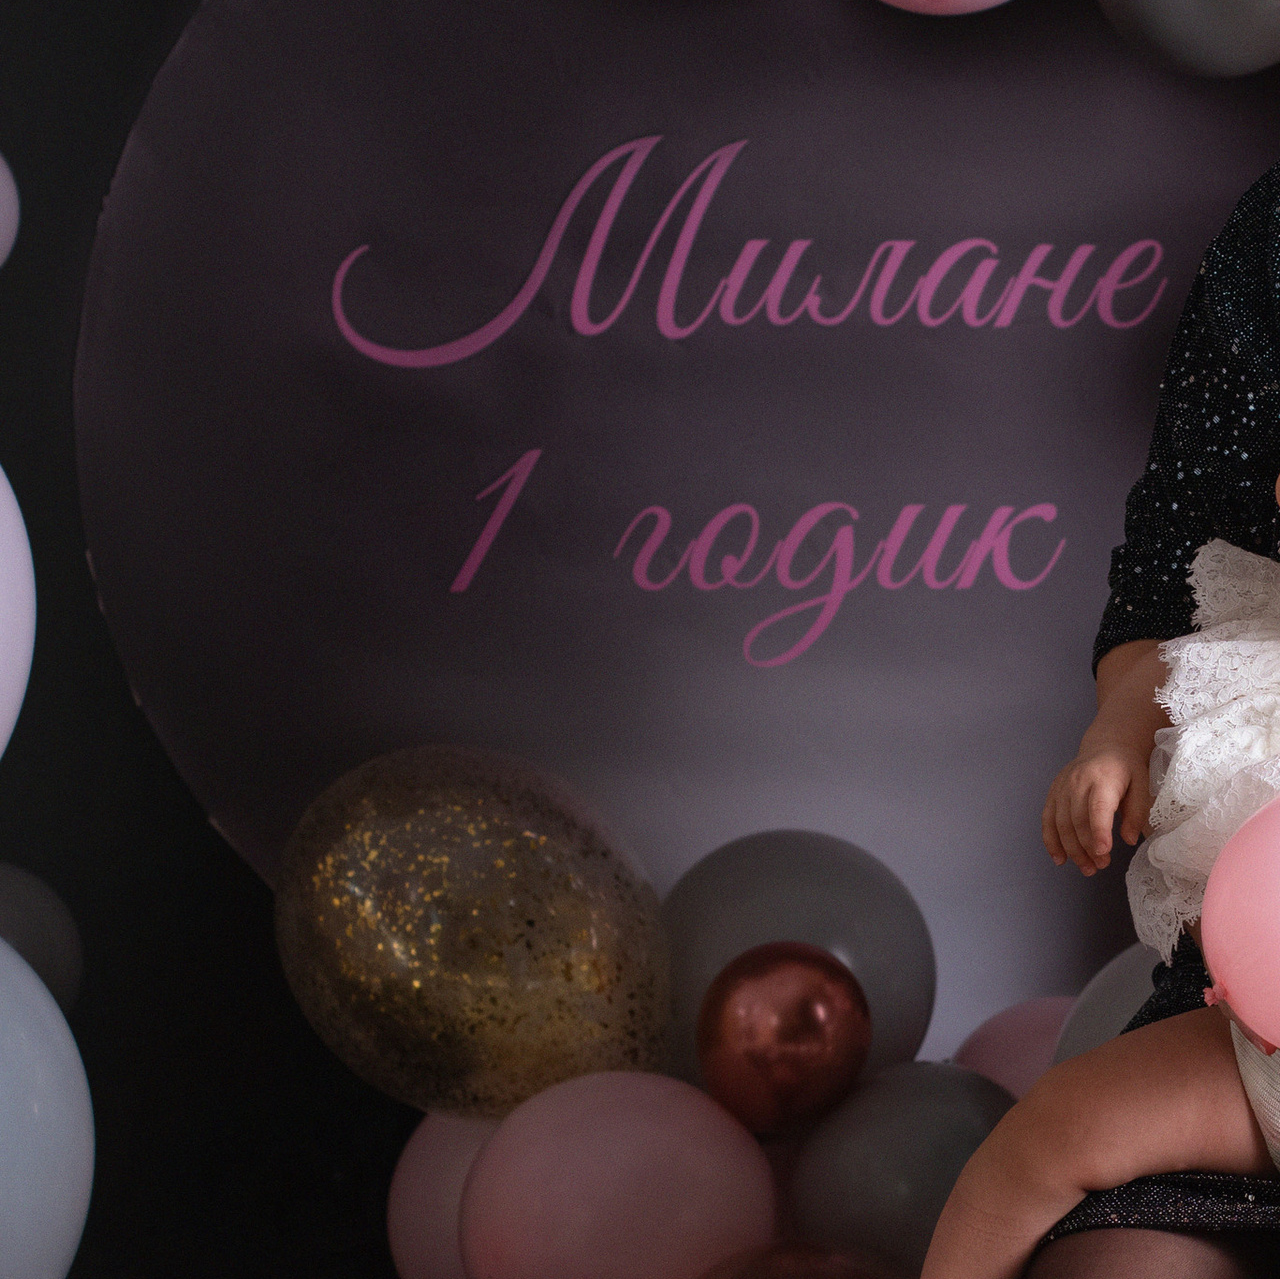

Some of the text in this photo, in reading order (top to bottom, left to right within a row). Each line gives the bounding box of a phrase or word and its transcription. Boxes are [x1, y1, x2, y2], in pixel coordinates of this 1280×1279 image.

[331, 135, 1168, 368] Милане
[450, 448, 1067, 668] 1 годик
